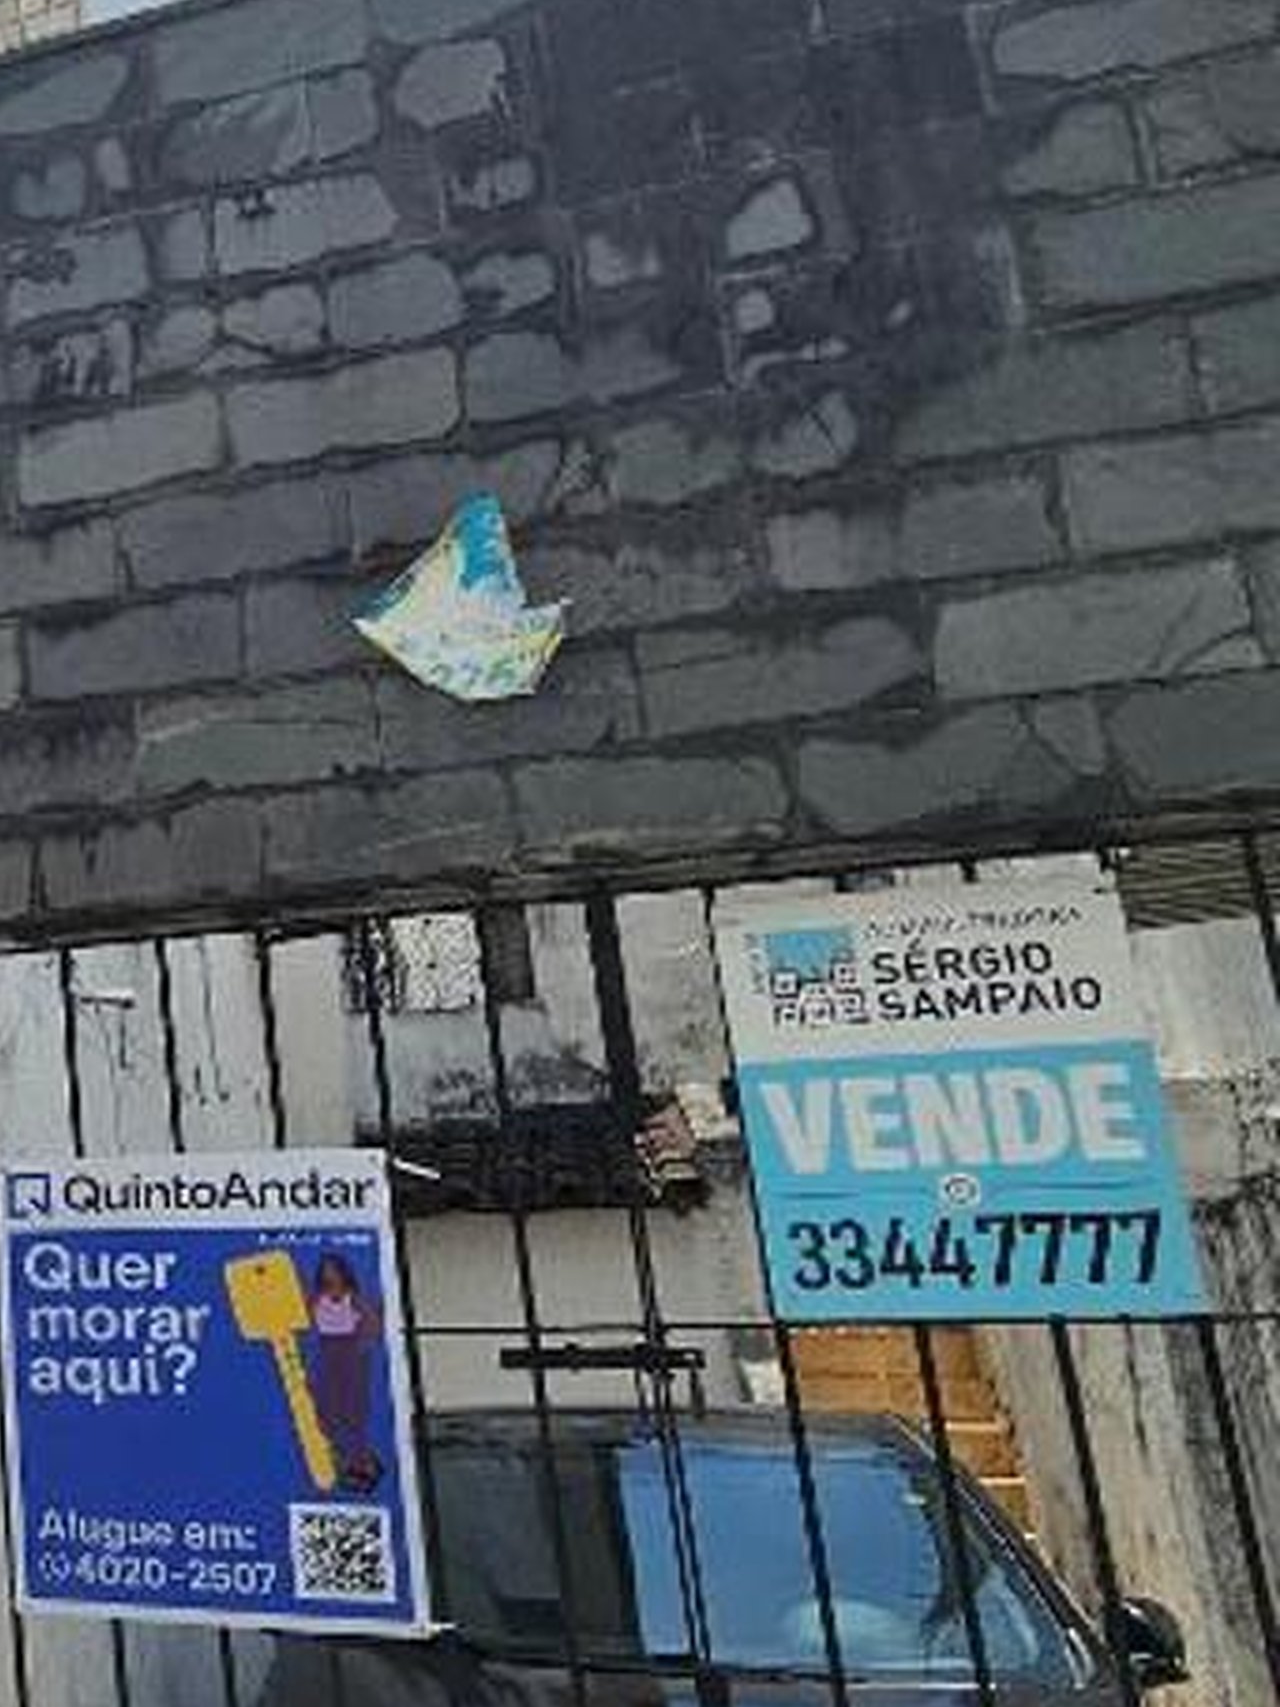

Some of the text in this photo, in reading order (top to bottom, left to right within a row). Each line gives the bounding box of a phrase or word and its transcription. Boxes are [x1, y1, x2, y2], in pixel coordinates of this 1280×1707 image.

[871, 937, 1053, 984] SÉRGIO
[877, 975, 1102, 1021] SAMPAIO
[758, 1060, 1147, 1176] VENDE
[62, 1171, 375, 1213] QuintoAndar
[23, 1242, 177, 1292] Quer
[786, 1209, 1162, 1292] 33447777
[27, 1305, 211, 1343] morar
[27, 1344, 200, 1405] aqui?
[38, 1507, 175, 1553] Alugue
[76, 1551, 277, 1595] 4020-2507
